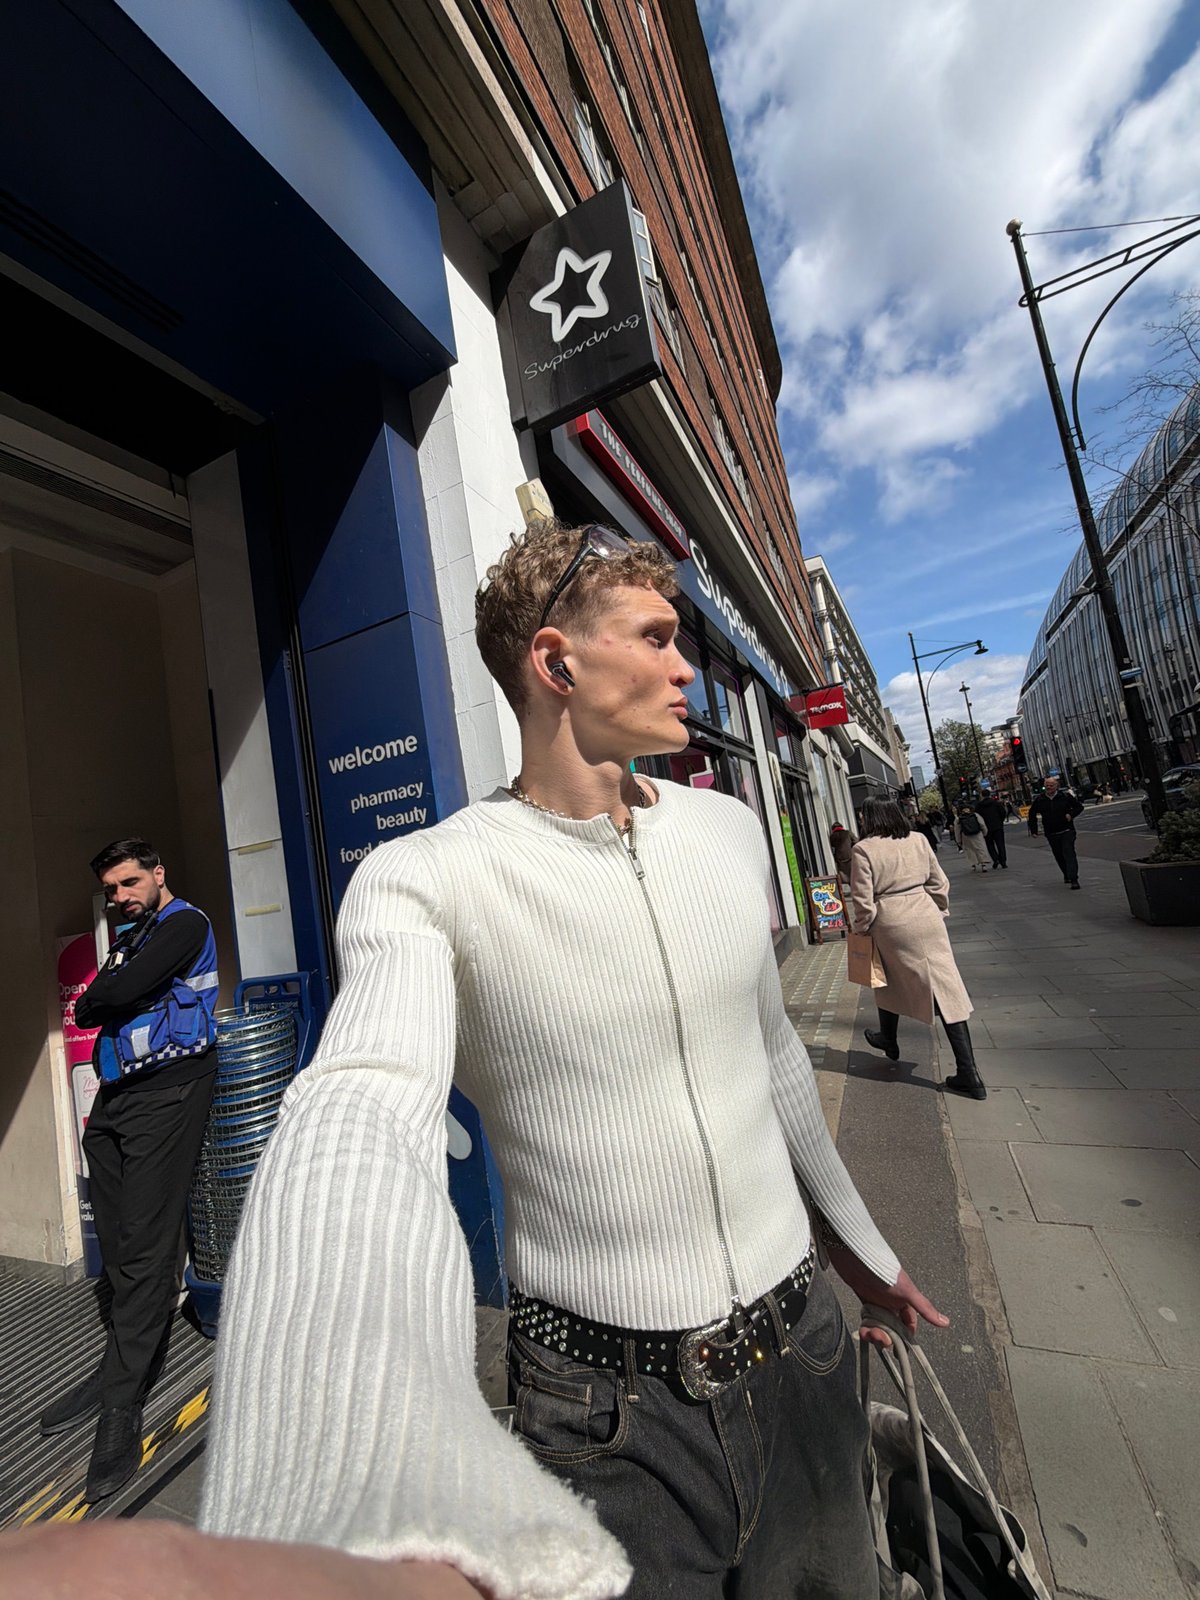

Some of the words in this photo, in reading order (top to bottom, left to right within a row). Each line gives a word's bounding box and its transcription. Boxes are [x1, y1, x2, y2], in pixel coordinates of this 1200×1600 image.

[524, 314, 642, 380] Superdrug
[600, 423, 621, 457] THE
[625, 455, 663, 511] PERFUME
[329, 735, 418, 774] welcome
[351, 782, 424, 813] pharmacy
[376, 806, 427, 830] beauty
[340, 841, 373, 863] food
